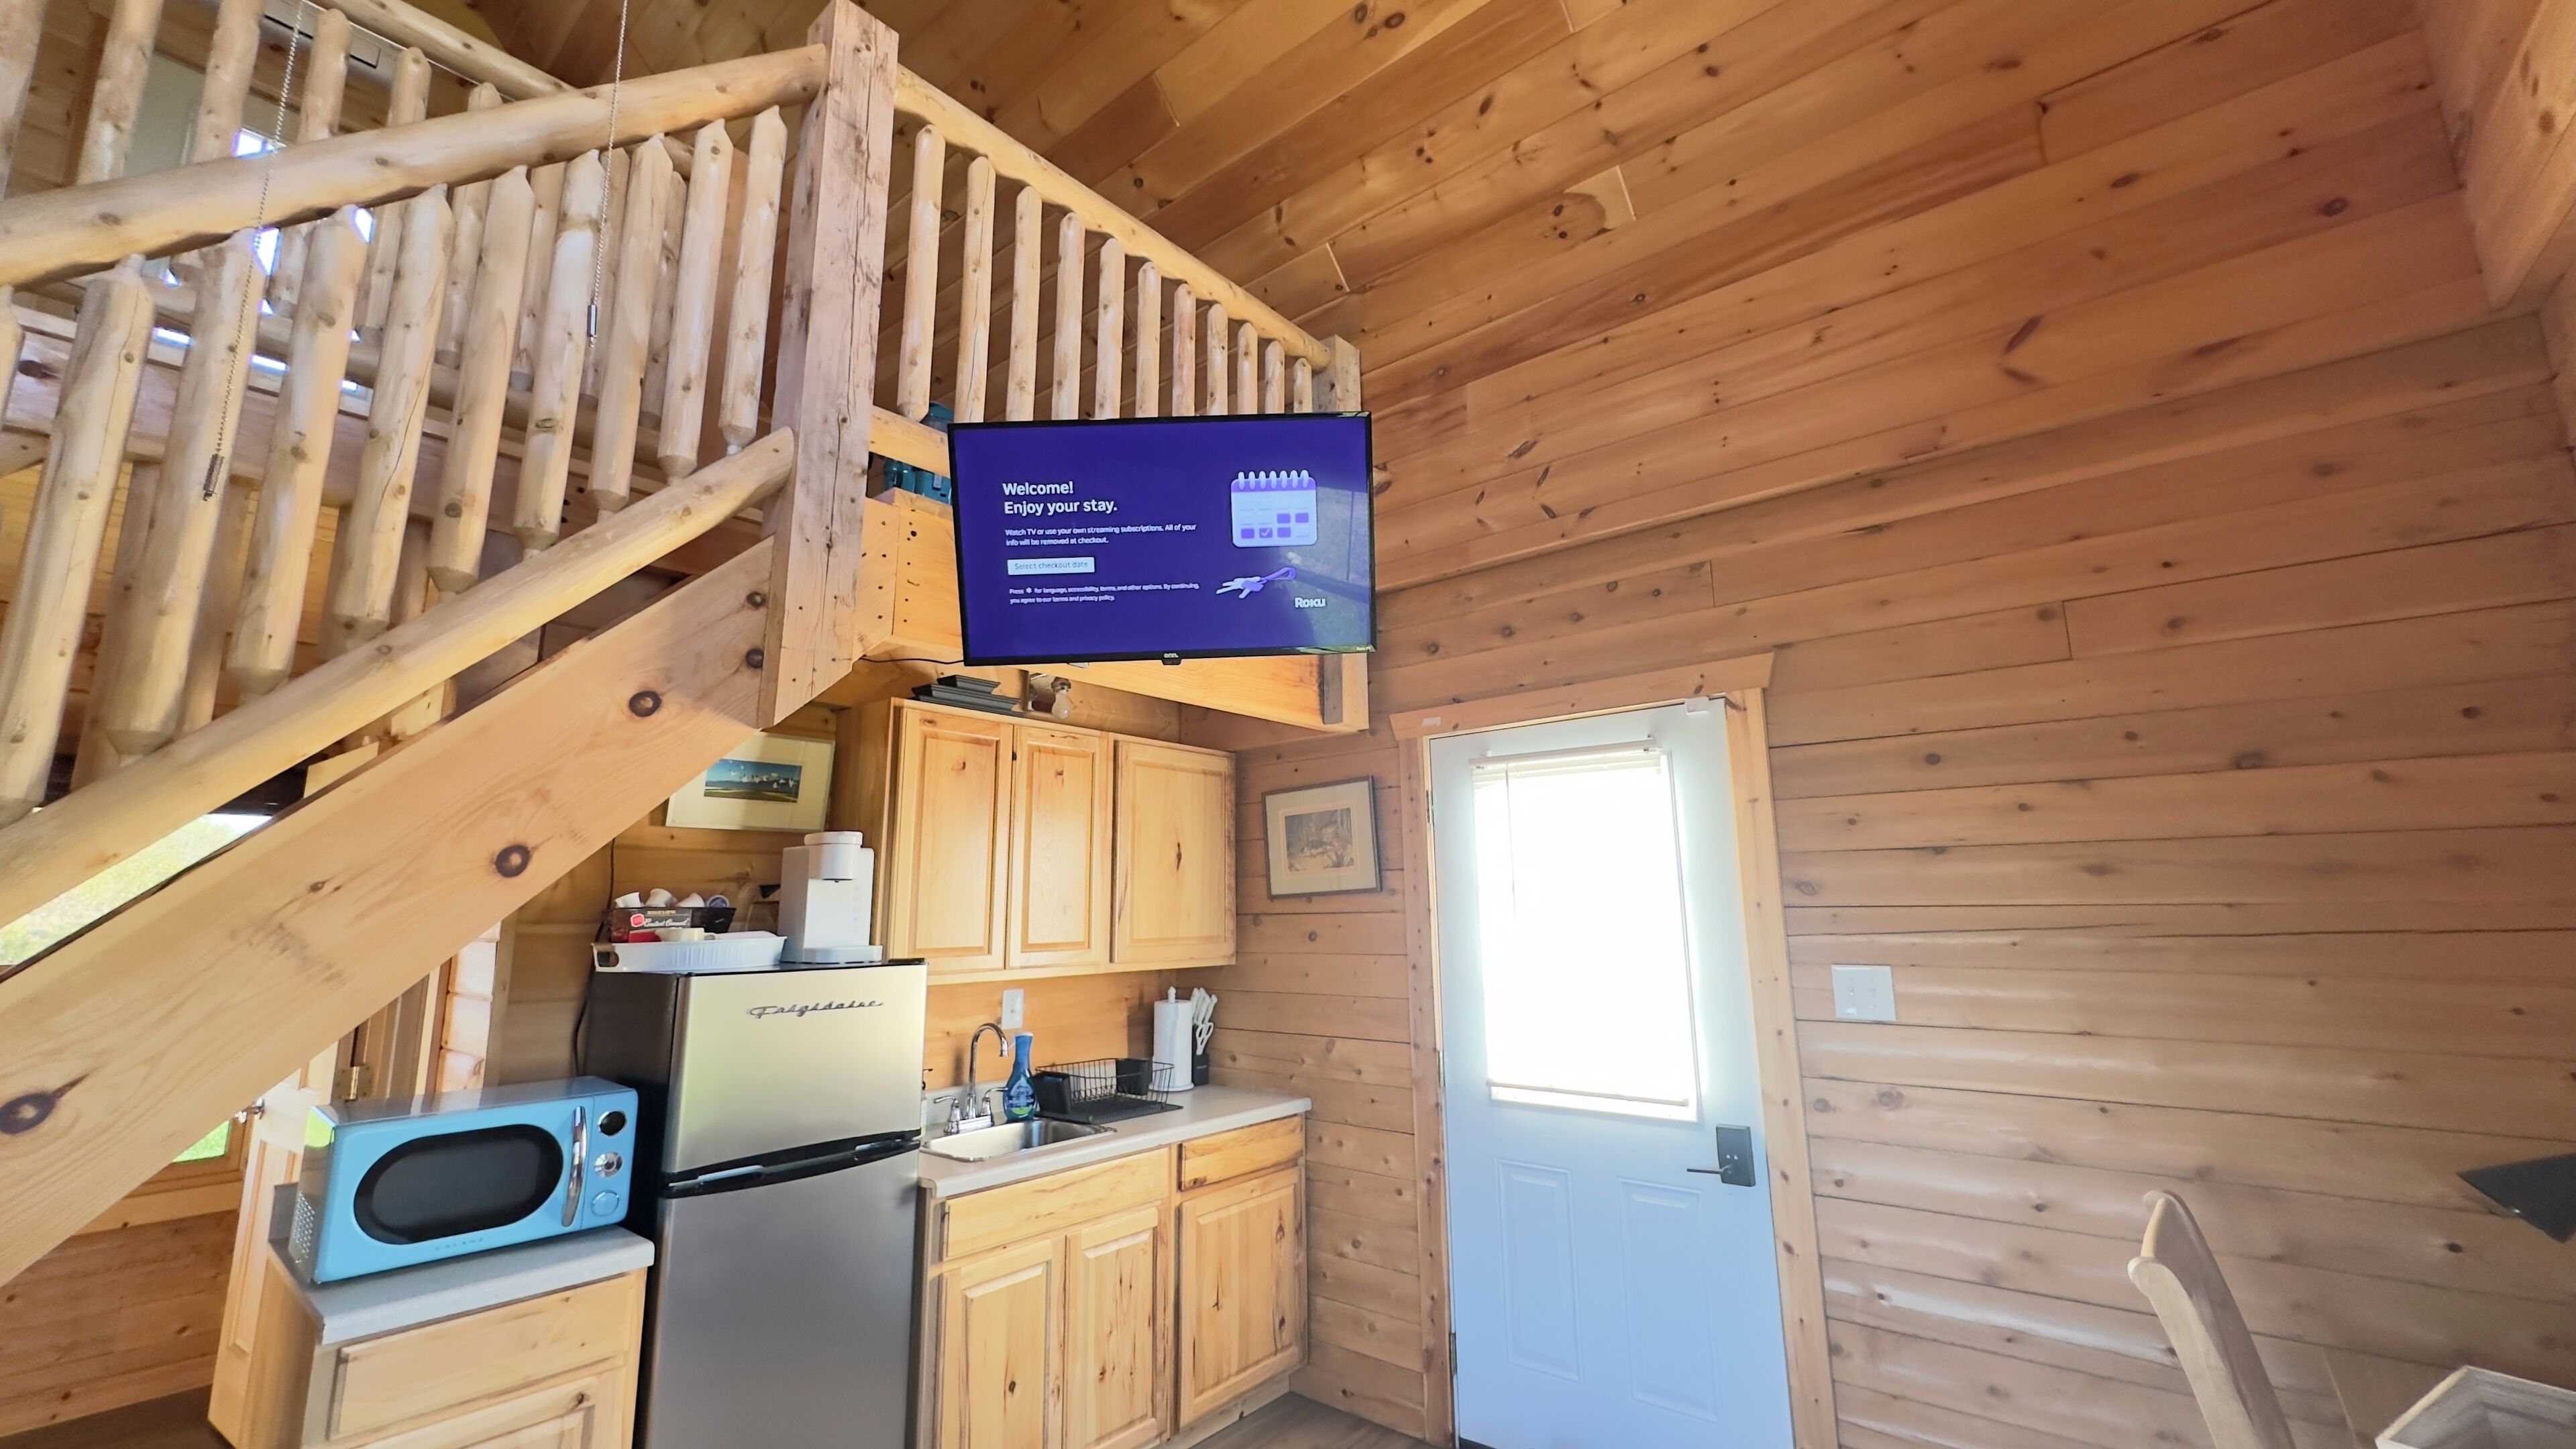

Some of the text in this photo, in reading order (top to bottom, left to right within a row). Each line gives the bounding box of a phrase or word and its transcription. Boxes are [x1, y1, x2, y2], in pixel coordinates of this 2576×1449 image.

[1002, 481, 1074, 495] Welcome!
[1004, 499, 1118, 517] Enjoy your stay.
[1077, 536, 1109, 544] checkout.
[748, 1000, 885, 1019] Frigidaire
